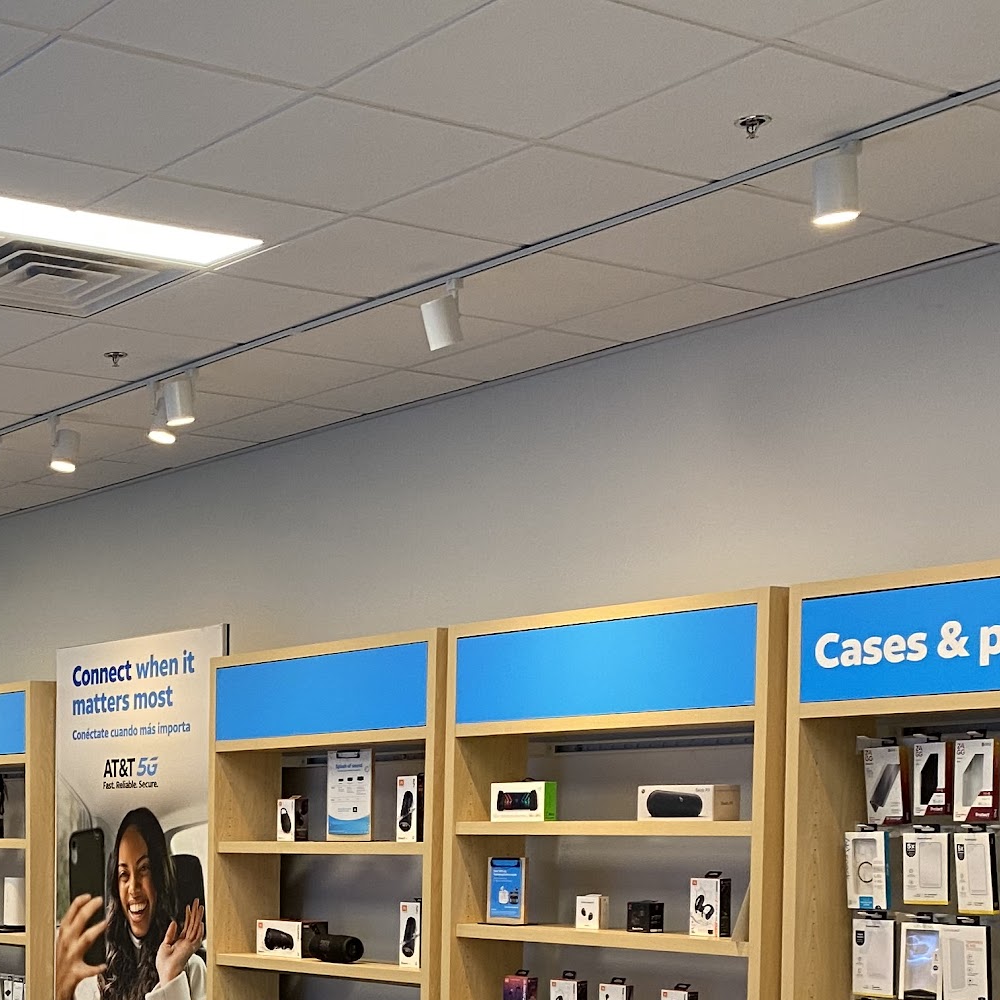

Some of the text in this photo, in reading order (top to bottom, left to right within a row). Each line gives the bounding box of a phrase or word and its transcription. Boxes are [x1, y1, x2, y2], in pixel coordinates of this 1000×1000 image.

[814, 632, 928, 669] Cases
[937, 620, 970, 659] &
[72, 649, 195, 687] Connect when it
[72, 686, 173, 716] matters most
[72, 721, 191, 740] Conéctate cuando más importa
[103, 756, 159, 778] AT&T 5G
[102, 780, 159, 790] Fast. Reliable. Secure.
